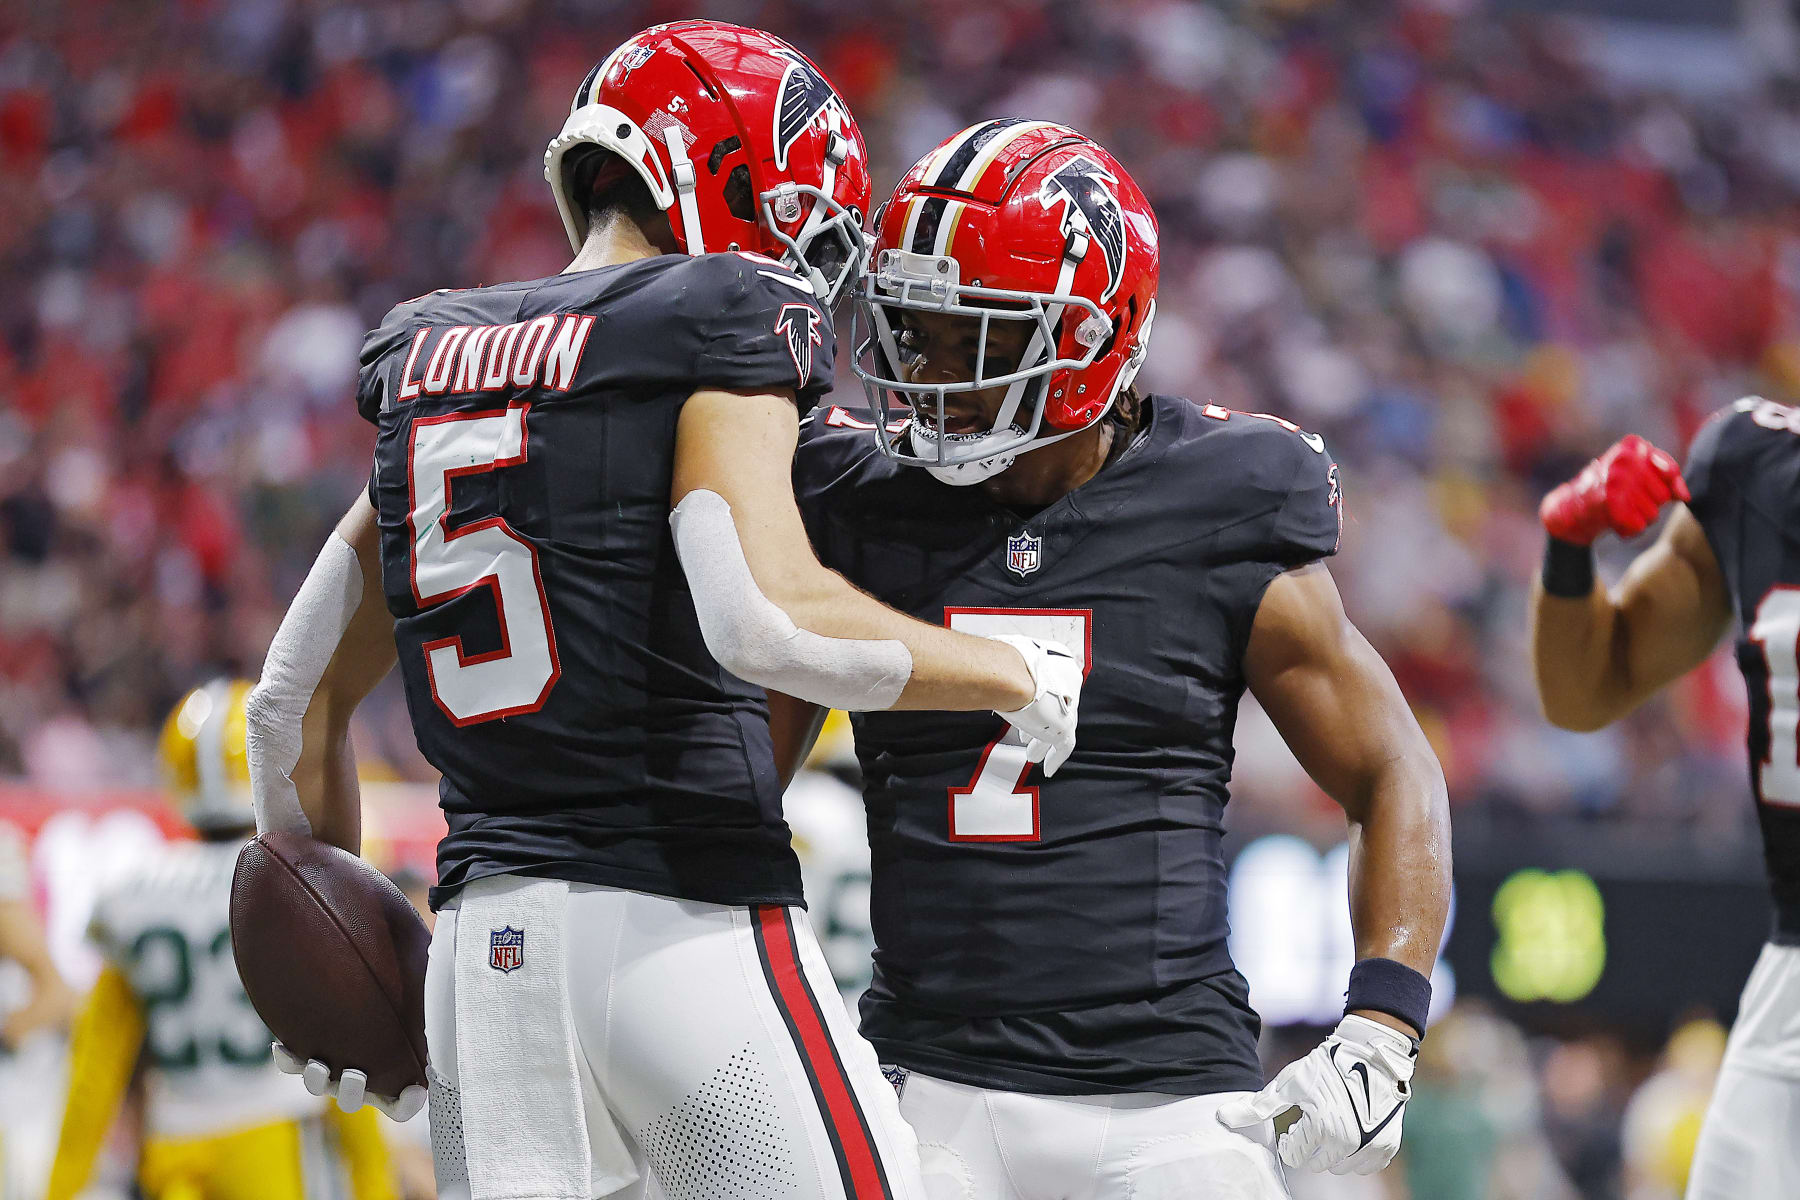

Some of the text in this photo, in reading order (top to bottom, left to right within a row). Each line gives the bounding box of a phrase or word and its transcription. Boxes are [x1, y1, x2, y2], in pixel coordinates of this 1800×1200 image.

[398, 314, 597, 402] LONDON
[406, 400, 562, 728] 5
[1012, 552, 1035, 569] NFL
[944, 606, 1093, 842] 7
[493, 946, 521, 969] NFL
